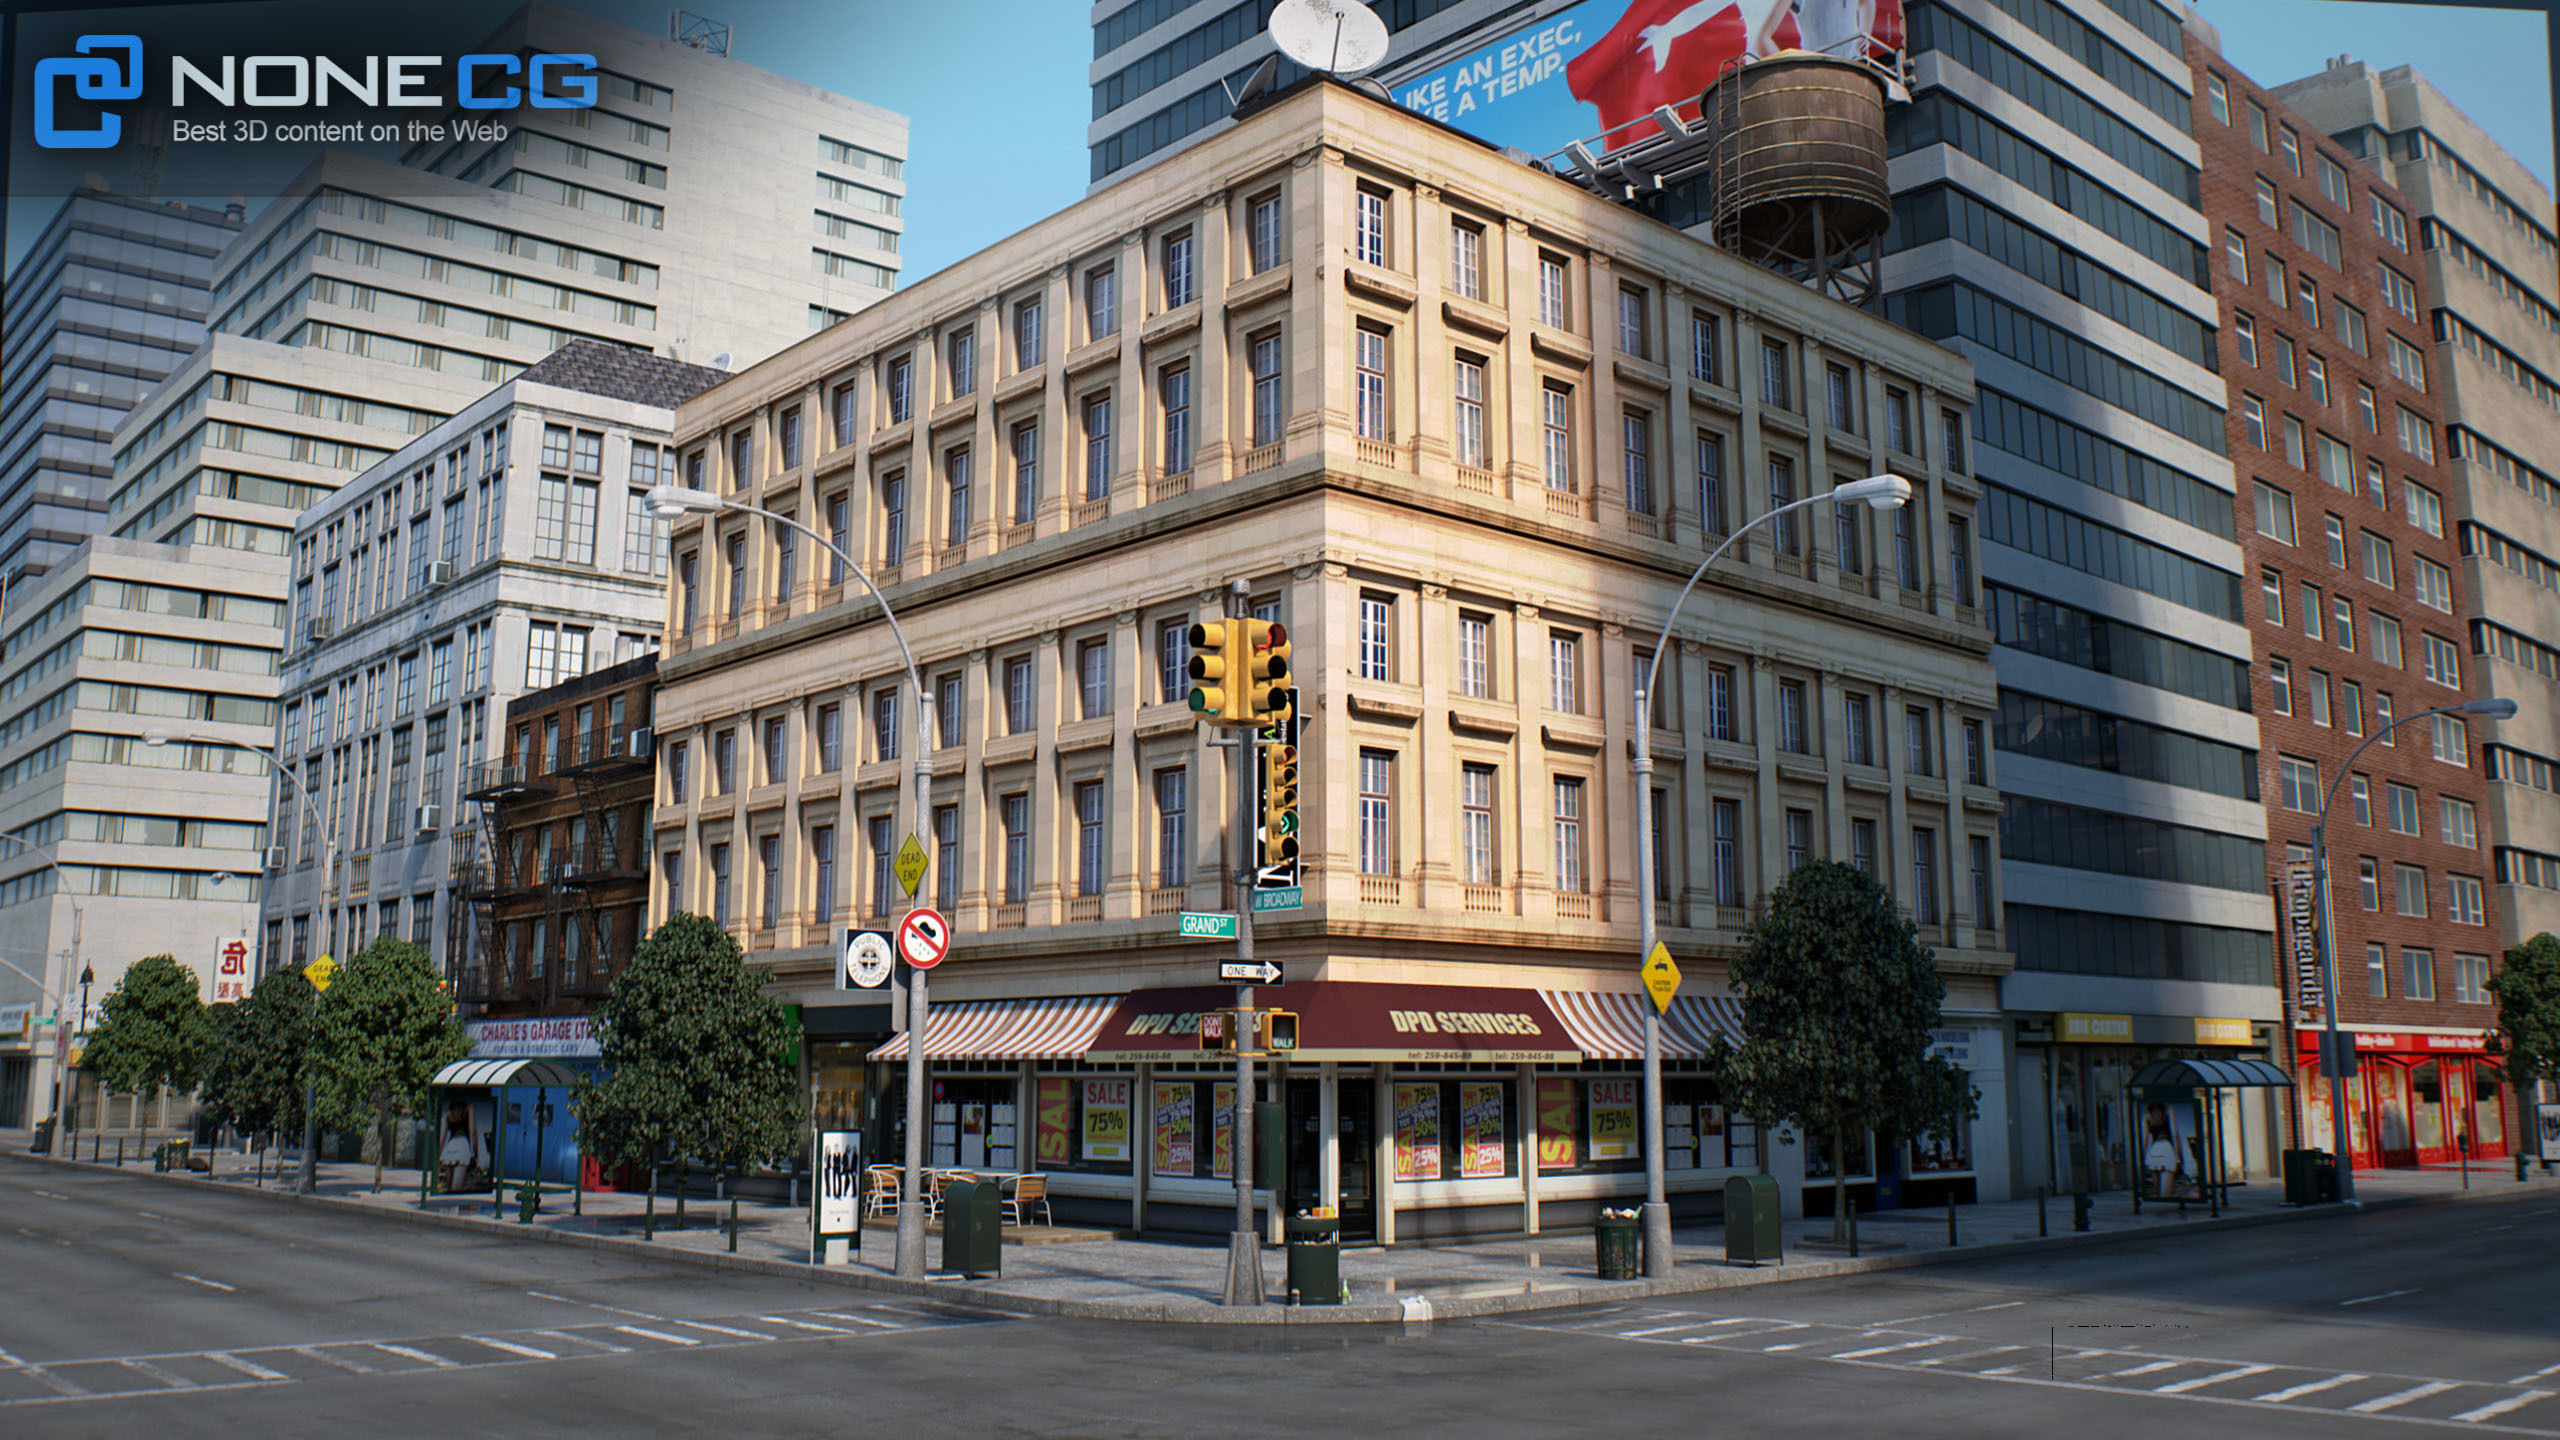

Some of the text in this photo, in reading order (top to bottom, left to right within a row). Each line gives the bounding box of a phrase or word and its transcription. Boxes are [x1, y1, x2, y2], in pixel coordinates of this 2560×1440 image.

[1394, 20, 1582, 111] IKE AN EXEC,
[1456, 91, 1476, 118] A
[1482, 52, 1566, 104] TEMP.
[901, 852, 920, 865] DEAD
[903, 870, 918, 882] END
[1255, 890, 1301, 908] W BROADWAY
[1183, 916, 1229, 934] GRAND ST
[854, 934, 887, 950] PUBLIC
[2290, 869, 2324, 1007] Propaganda
[851, 960, 889, 986] TELEPHONE
[1227, 965, 1275, 978] ONE WAY
[1125, 1013, 1175, 1035] DPD
[1203, 1015, 1223, 1027] DONT
[1389, 1010, 1542, 1035] DPD SERVICES
[481, 1023, 528, 1042] CHARLIE'S
[530, 1021, 572, 1041] GARAGE
[1272, 1036, 1294, 1049] WALK
[1087, 1082, 1126, 1105] SALE
[1593, 1081, 1633, 1105] SALE
[1089, 1111, 1124, 1133] 75%
[1595, 1110, 1632, 1133] 75%
[1171, 1146, 1192, 1164] 25%
[1414, 1148, 1438, 1167] 25%
[1479, 1146, 1501, 1165] 25%
